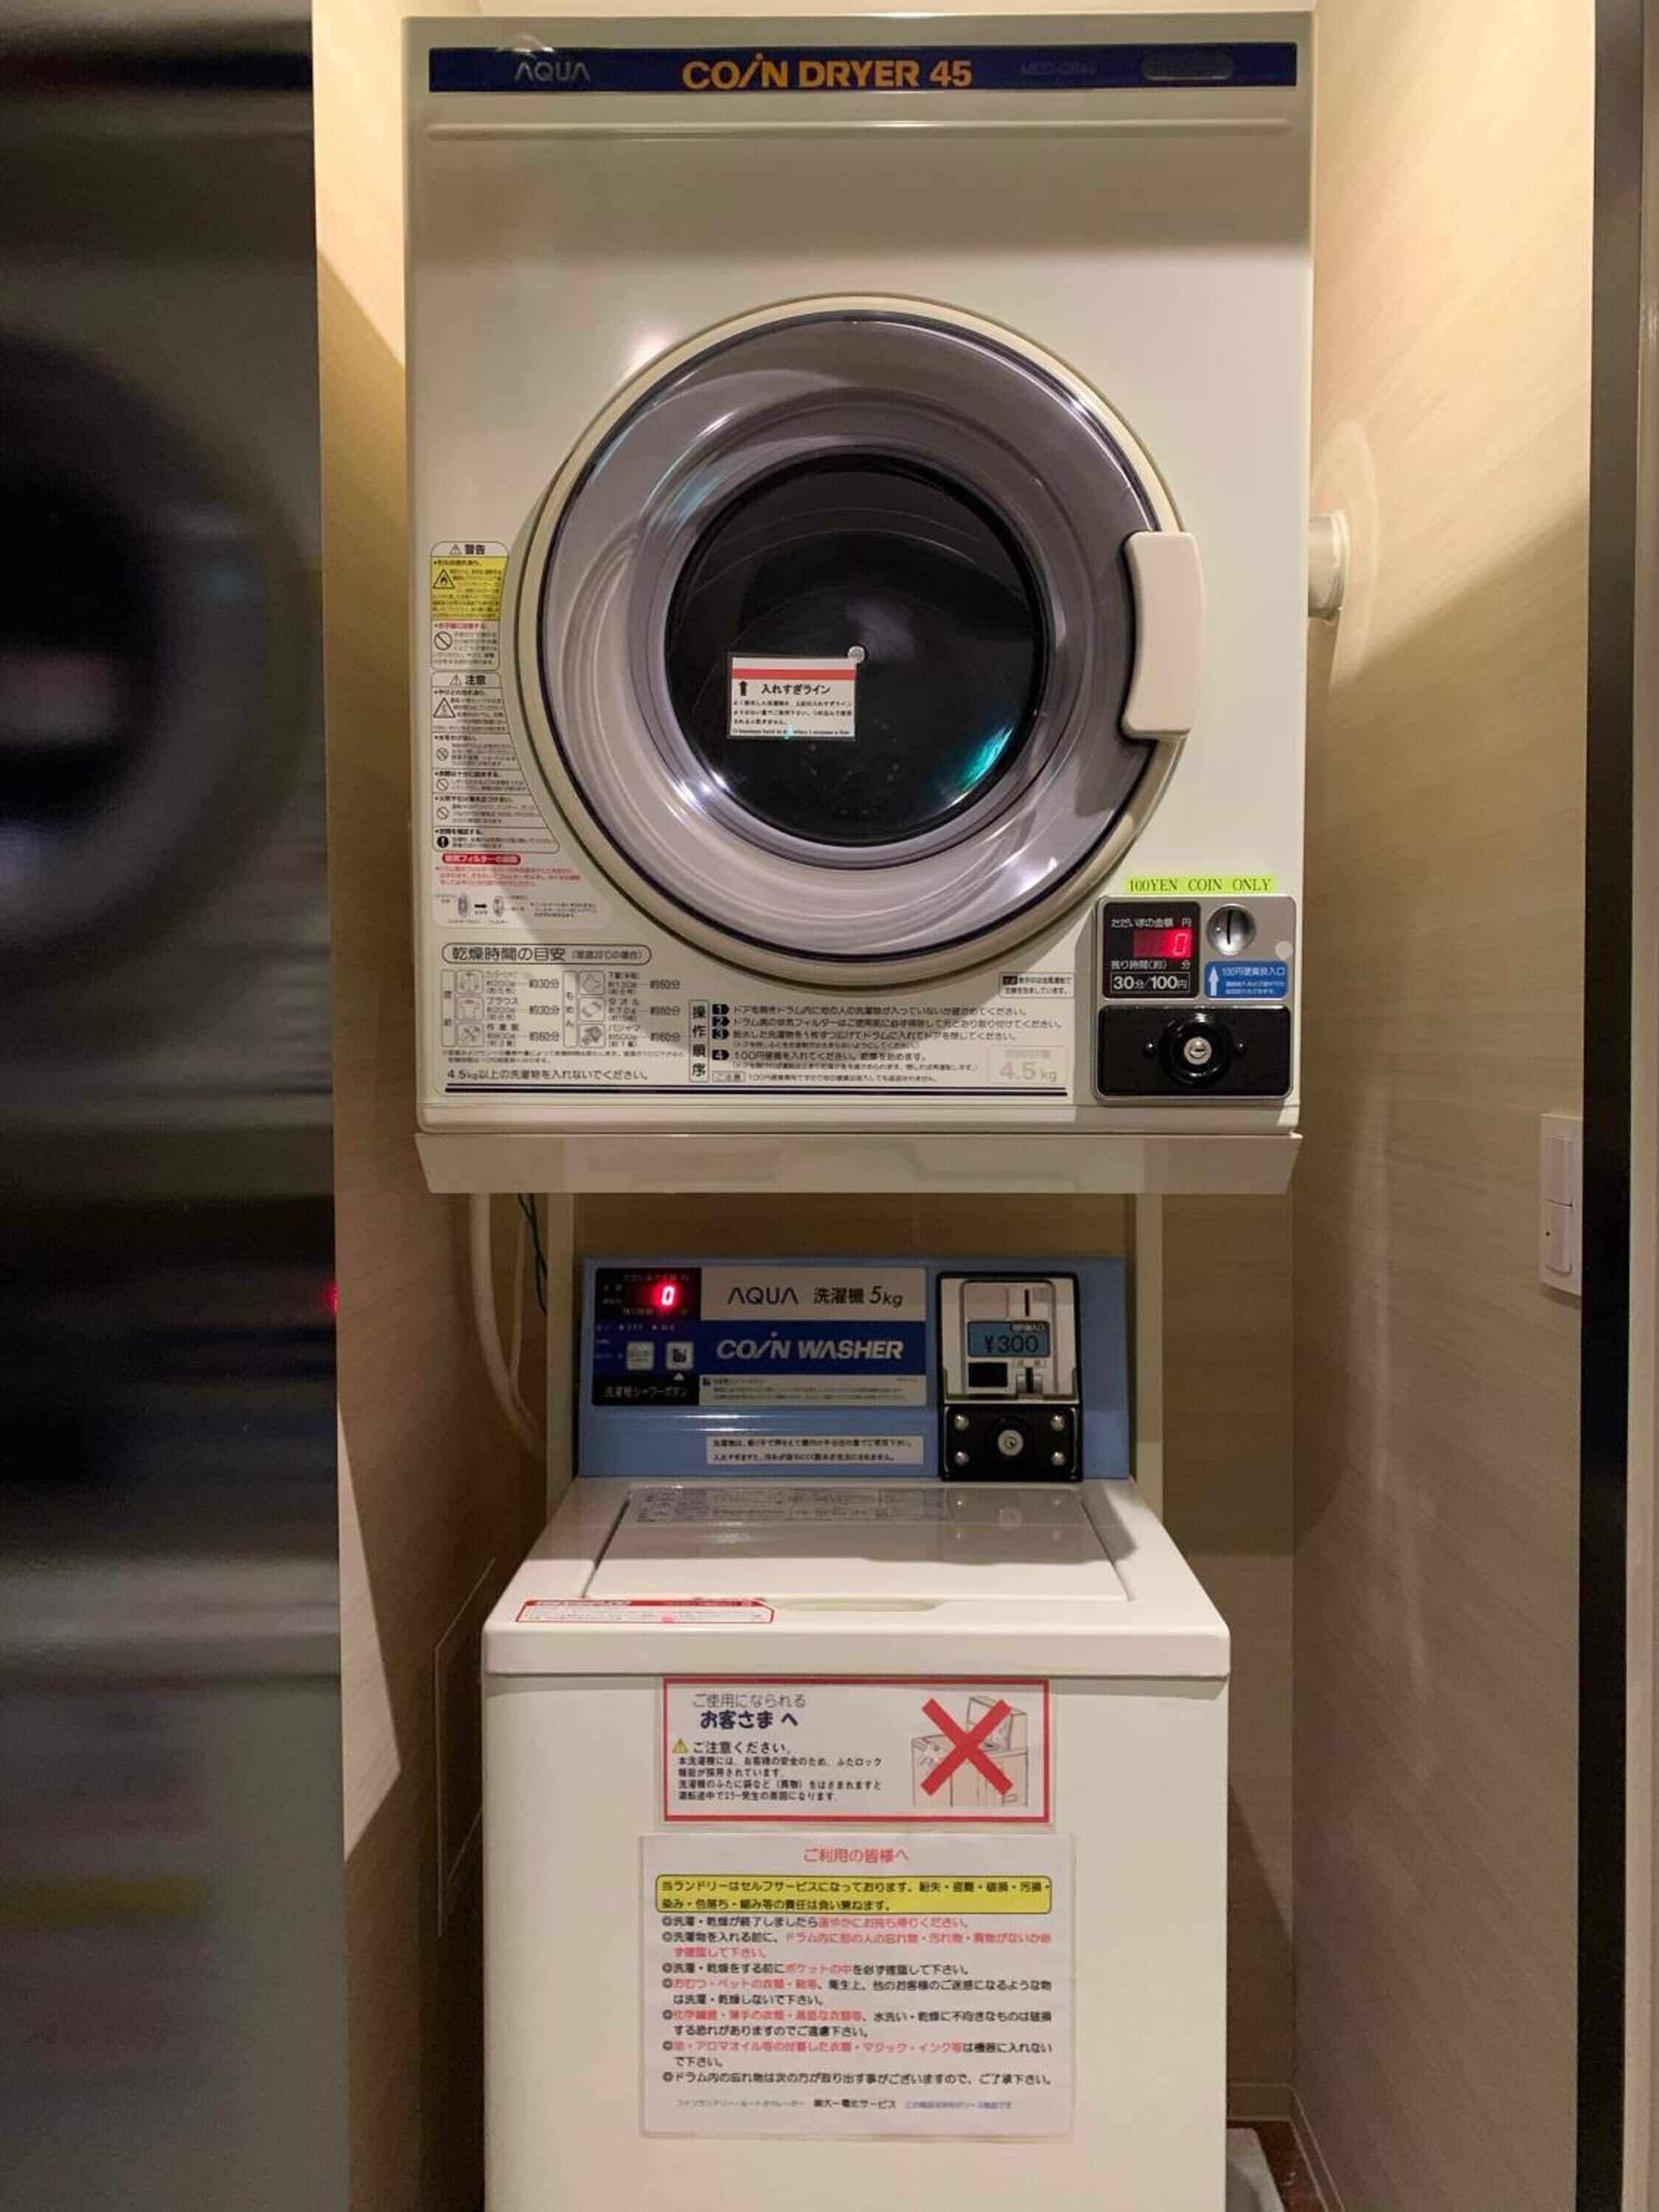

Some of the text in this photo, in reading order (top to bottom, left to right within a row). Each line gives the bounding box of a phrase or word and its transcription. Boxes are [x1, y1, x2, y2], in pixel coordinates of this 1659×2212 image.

[516, 64, 590, 83] AQUA
[683, 53, 787, 89] COIN
[800, 60, 919, 88] DRYER
[930, 60, 973, 87] 45
[465, 675, 486, 685] 注意
[761, 684, 831, 695] 入れすぎライン
[1129, 879, 1272, 891] 100YEN COIN ONLY
[1172, 932, 1189, 956] 0
[452, 947, 566, 961] 乾燥時間の目安
[660, 1285, 675, 1307] 0
[726, 1285, 903, 1308] AQUA 洗濯機 5kg
[717, 1330, 905, 1360] COIN WASHER
[984, 1335, 1039, 1354] ¥300
[692, 1694, 807, 1708] ご使用になられる
[700, 1710, 799, 1730] お客さま へ
[692, 1740, 792, 1755] ご注意ください。
[678, 1756, 883, 1767] 本洗濯機には、お客様の安全のため、ふたロック
[678, 1768, 784, 1778] 機能が採用されています。
[803, 1848, 909, 1864] ご利用の皆様へ
[673, 1994, 823, 2006] は洗濯・乾燥しないで下さい。
[675, 2056, 723, 2067] で下さい。
